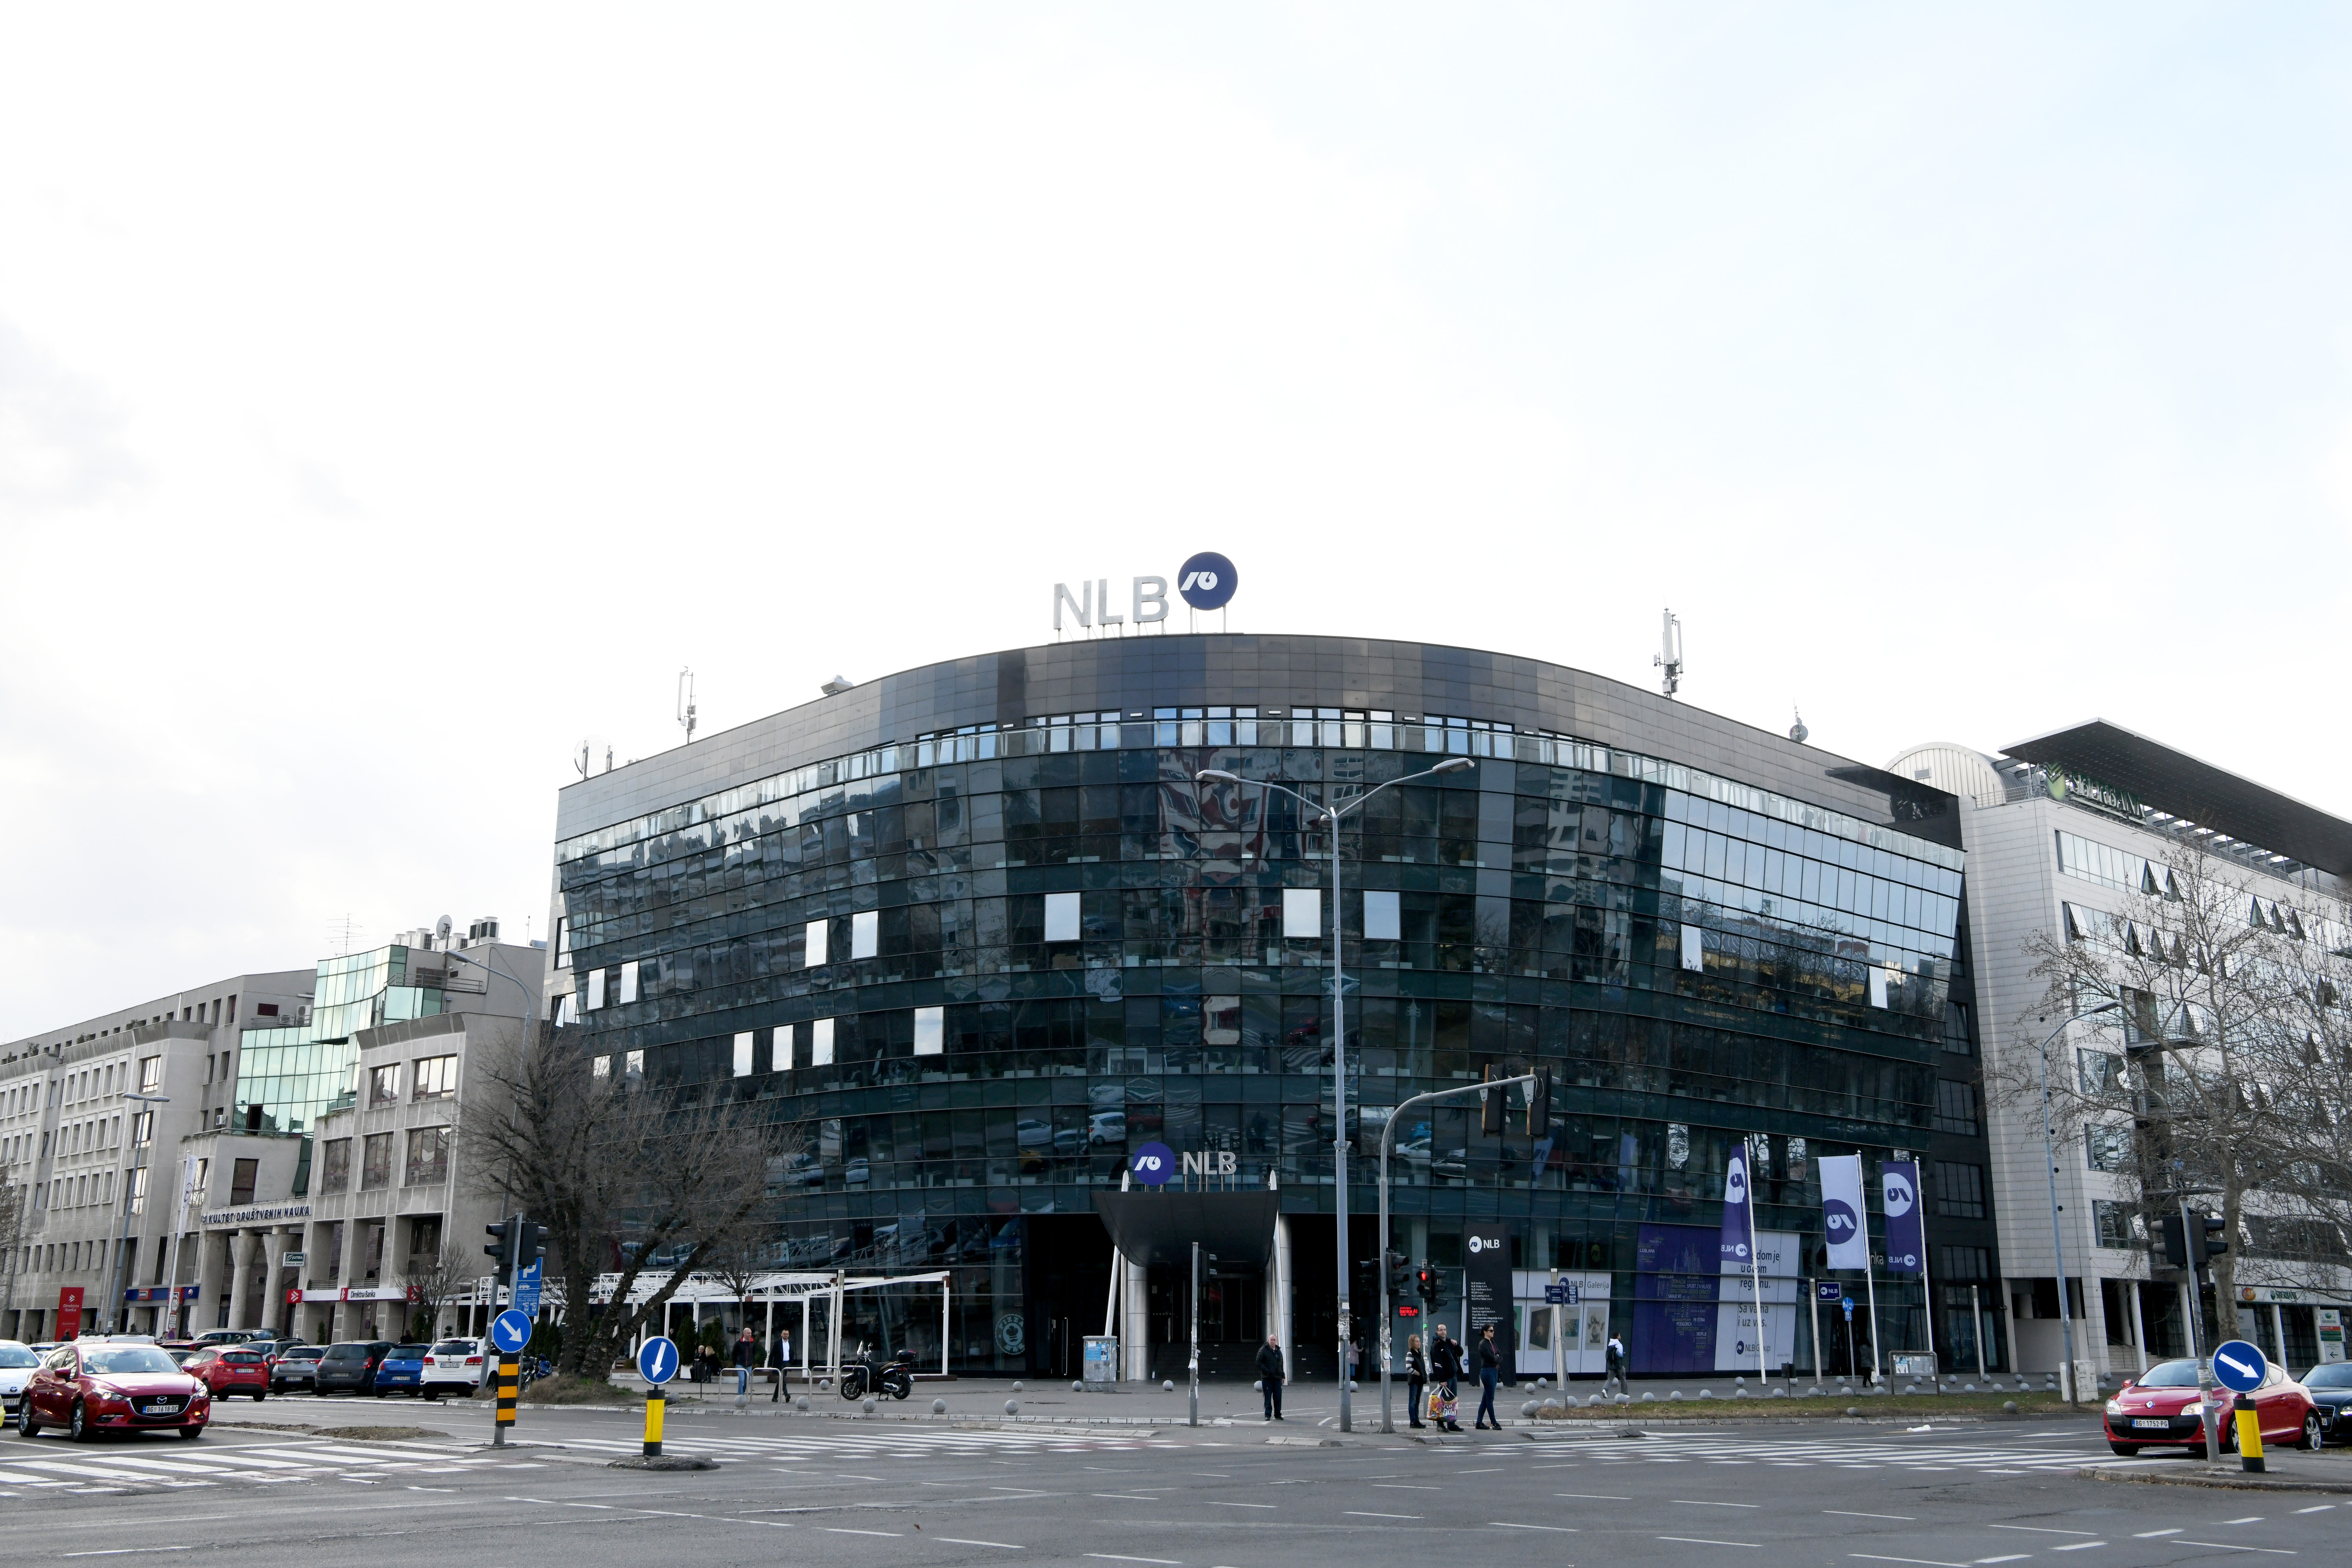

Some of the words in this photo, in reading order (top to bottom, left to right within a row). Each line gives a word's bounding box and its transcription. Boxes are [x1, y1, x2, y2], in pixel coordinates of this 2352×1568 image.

[1053, 575, 1169, 629] NLB
[1183, 1152, 1237, 1175] NLB
[236, 1208, 282, 1222] DRUŠTVENIH
[285, 1205, 311, 1217] NAUKA
[1483, 1239, 1500, 1249] NLB
[1756, 1249, 1772, 1261] dom
[1773, 1250, 1780, 1263] je
[1587, 1281, 1609, 1290] Galerija
[1740, 1278, 1770, 1291] reginu.
[1739, 1303, 1747, 1313] Sa
